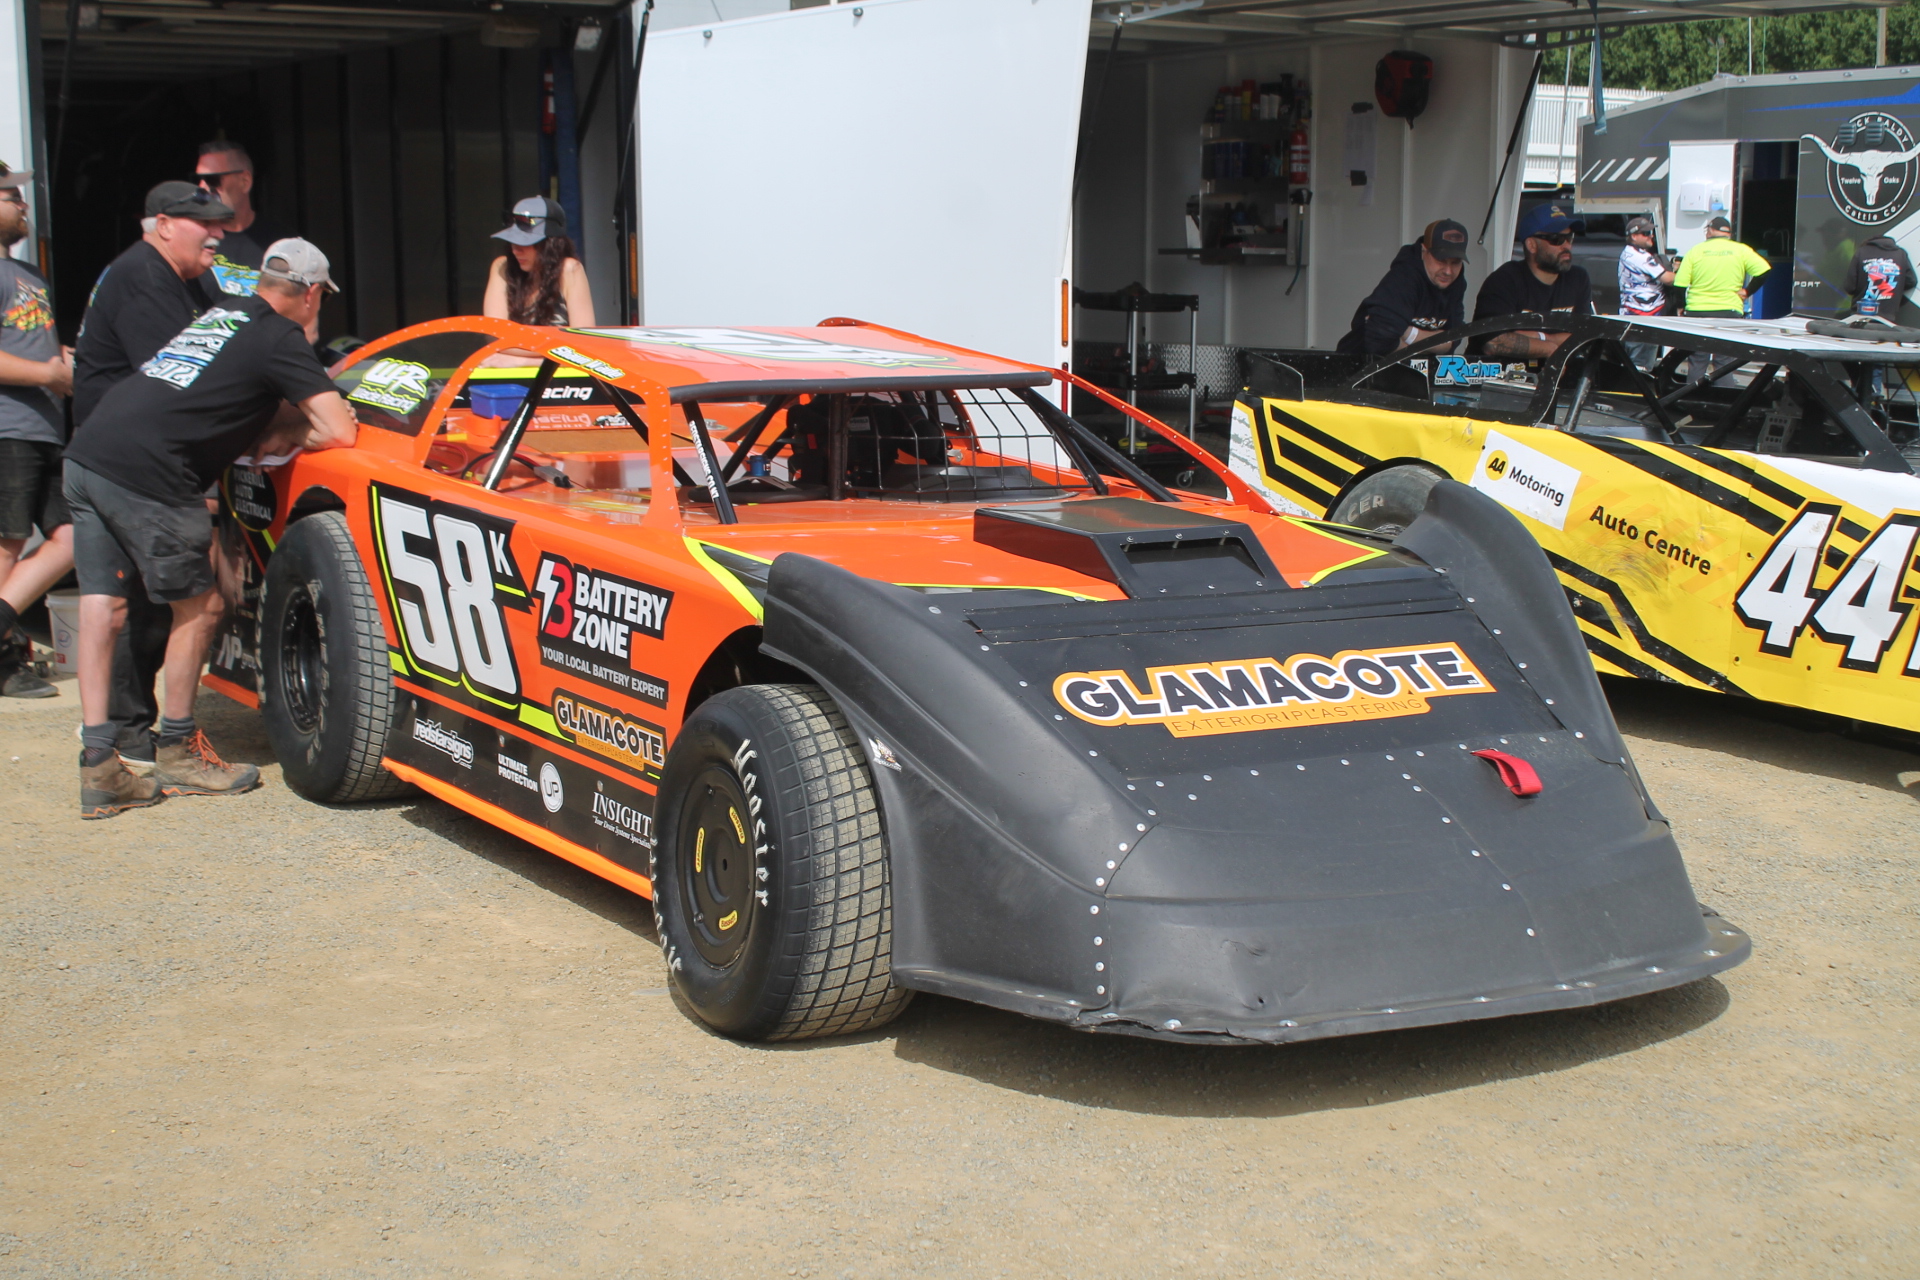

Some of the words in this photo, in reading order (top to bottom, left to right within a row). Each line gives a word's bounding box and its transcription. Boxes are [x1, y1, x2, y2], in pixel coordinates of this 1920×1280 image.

[1840, 177, 1862, 185] Twelve
[1883, 176, 1900, 184] Oaks
[1844, 205, 1878, 221] Cattle
[541, 385, 593, 401] acing
[1508, 466, 1565, 507] Motoring
[235, 498, 272, 522] ELECTRICAL
[1589, 505, 1639, 541] Auto
[1643, 528, 1712, 576] Centre
[379, 496, 518, 695] 58
[488, 529, 514, 577] K
[574, 571, 668, 631] BATTERY
[572, 609, 630, 660] ZONE
[542, 645, 563, 665] YOUR
[564, 654, 591, 674] LOCAL
[592, 663, 630, 688] BATTERY
[630, 679, 665, 701] EXPERT
[1062, 649, 1482, 720] GLAMACOTE
[556, 699, 663, 765] GLAMACOTE
[1171, 712, 1281, 733] EXTERIOR
[1290, 698, 1424, 723] PLASTERING
[414, 720, 473, 762] redstarsigns
[497, 753, 529, 776] ULTIMATE
[497, 765, 539, 793] PROTECTION
[592, 791, 652, 838] INSIGHT
[731, 738, 769, 907] Hoosier
